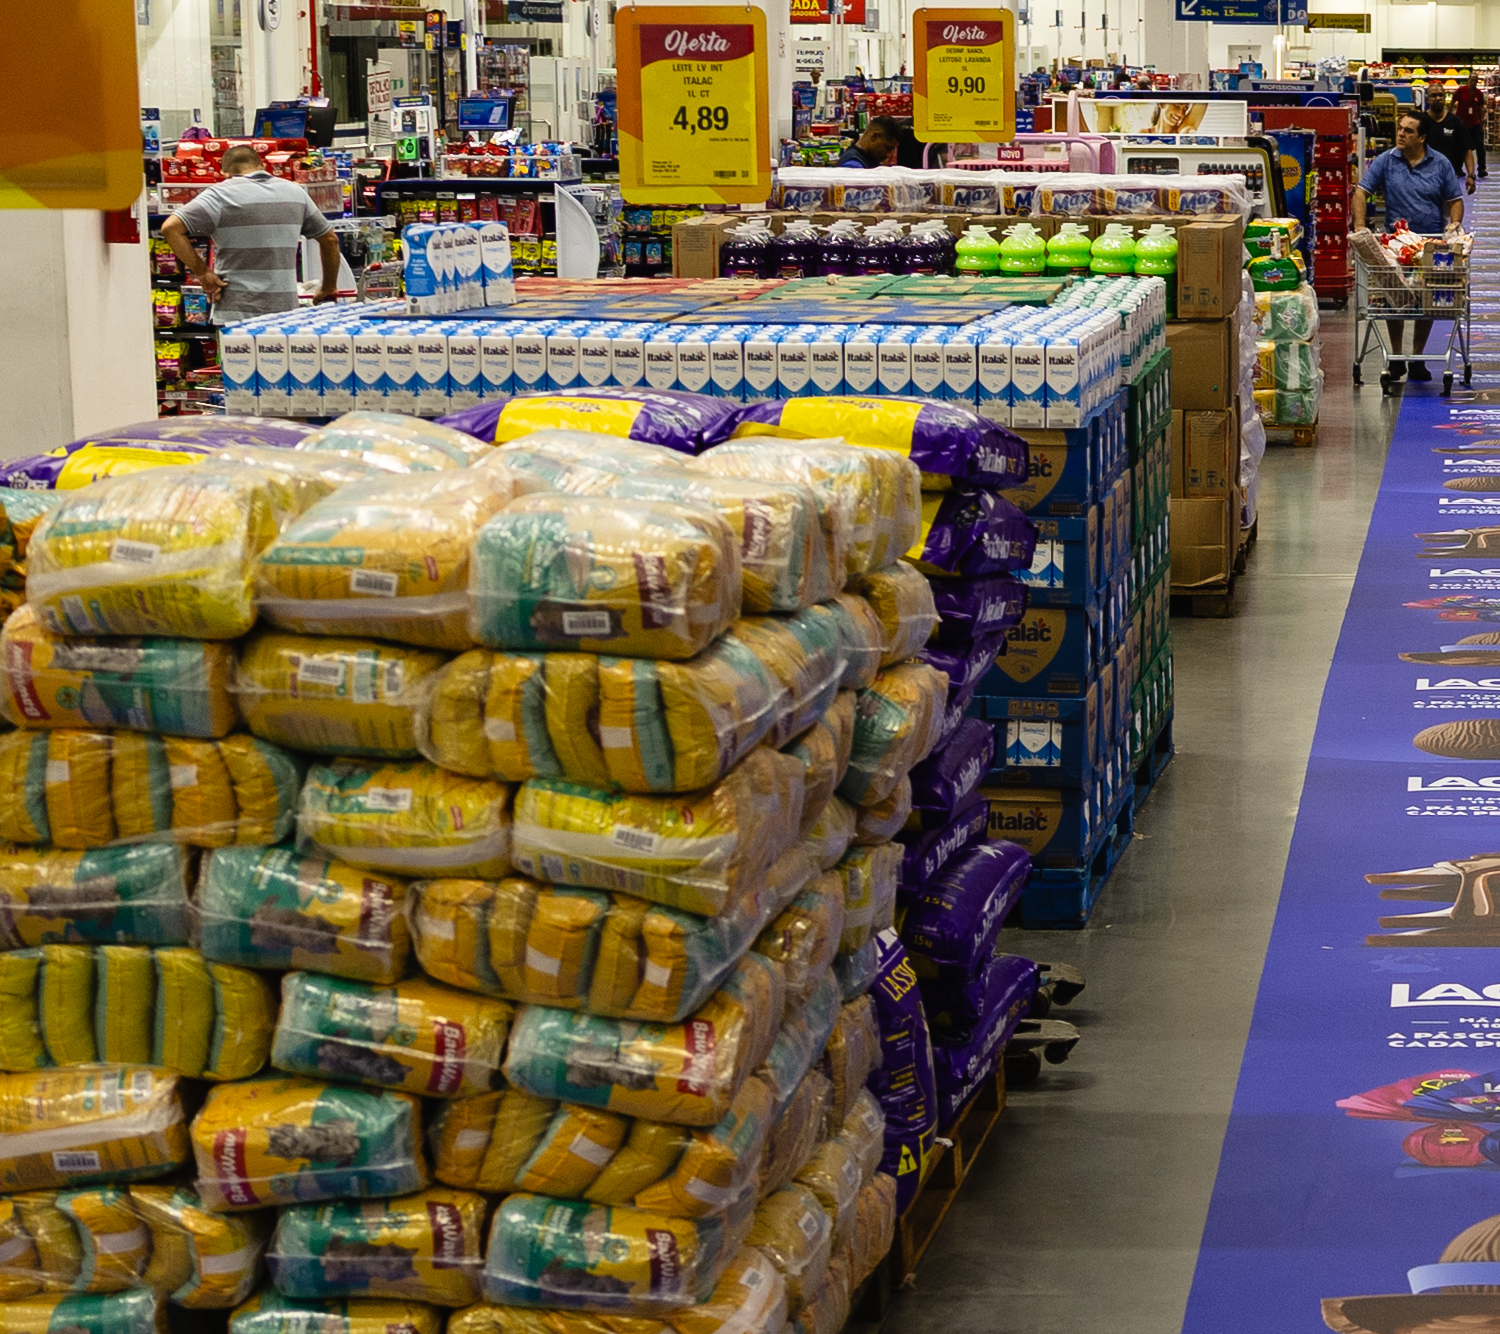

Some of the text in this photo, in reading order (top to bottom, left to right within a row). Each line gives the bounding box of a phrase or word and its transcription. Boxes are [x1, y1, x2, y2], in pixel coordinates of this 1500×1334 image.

[943, 25, 987, 44] Oferta
[665, 30, 731, 56] Oferta
[672, 64, 723, 72] LEITE LV INT
[684, 77, 713, 85] ITALAC
[948, 76, 986, 97] 9,90
[687, 90, 710, 98] 1L CT
[673, 105, 729, 135] 4,89
[1001, 149, 1020, 159] NOVO
[953, 188, 993, 207] Max
[225, 344, 251, 355] Italac
